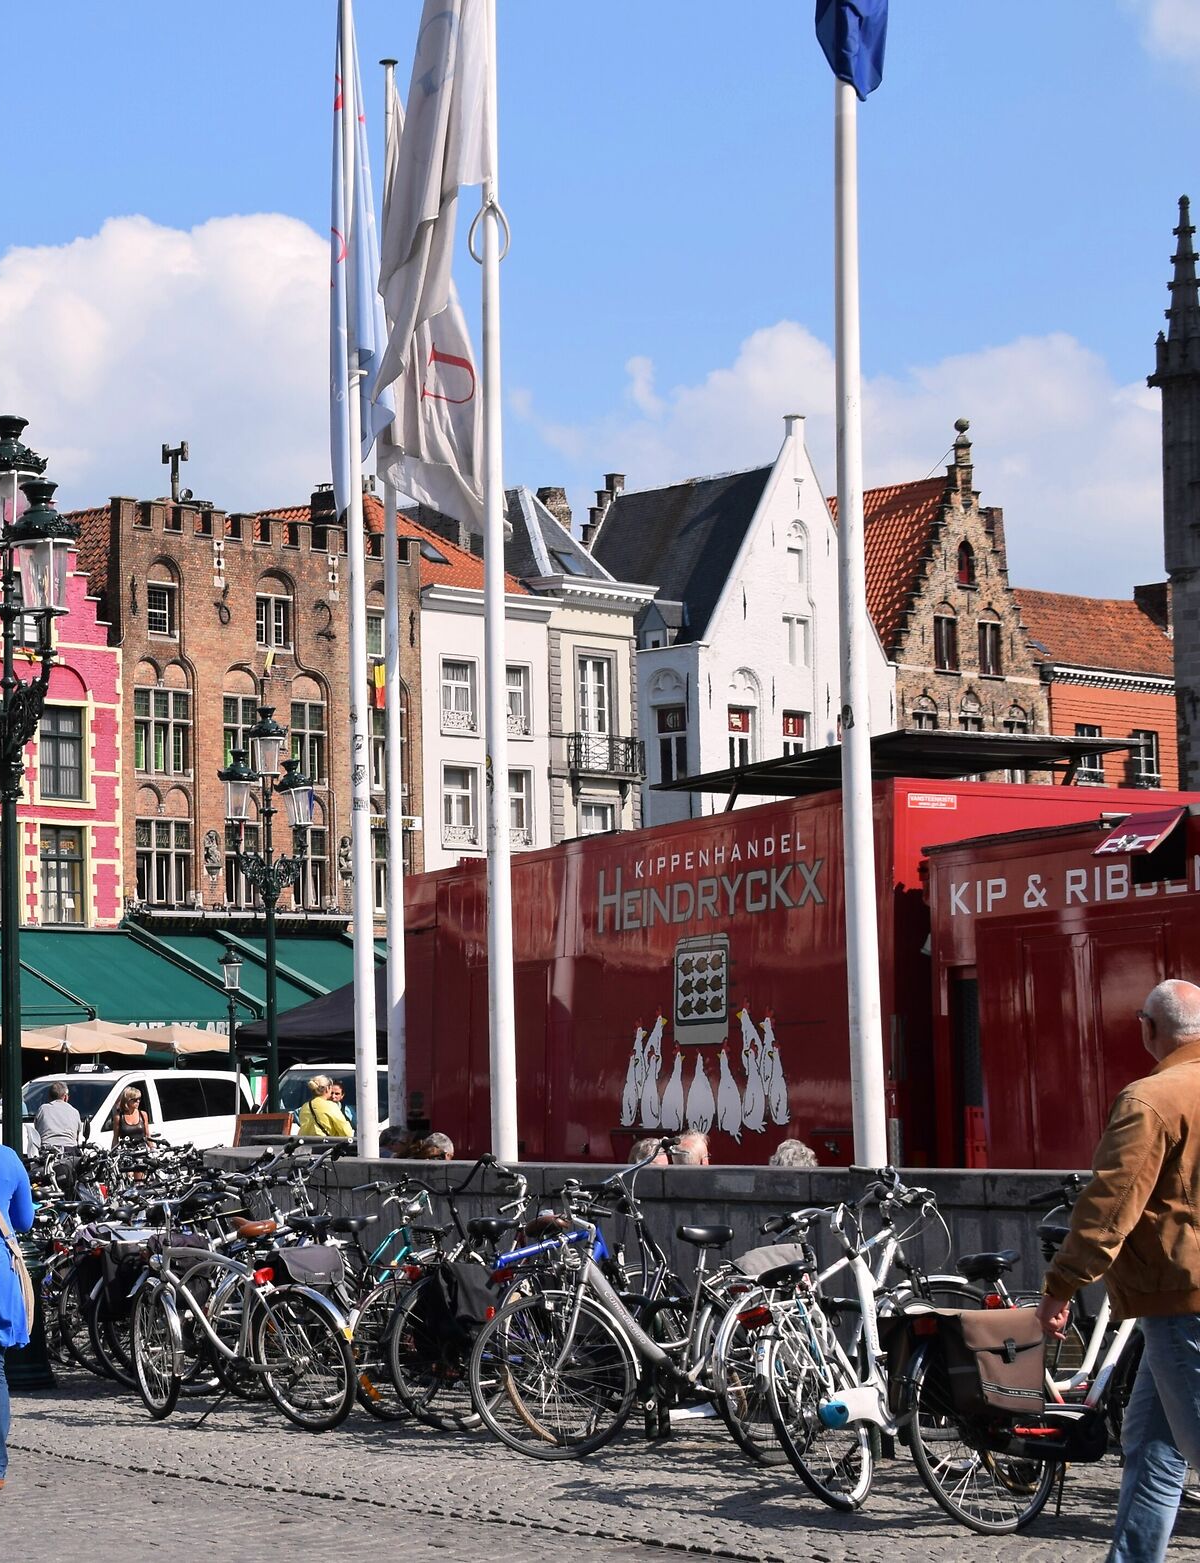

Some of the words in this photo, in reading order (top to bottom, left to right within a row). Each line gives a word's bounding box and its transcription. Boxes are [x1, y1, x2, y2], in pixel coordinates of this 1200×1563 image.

[635, 832, 806, 879] KIPPENHANDEL
[950, 878, 1007, 916] KIP
[1023, 874, 1048, 908] &
[1066, 854, 1200, 904] RIB
[597, 858, 825, 934] HEINDRYCKX
